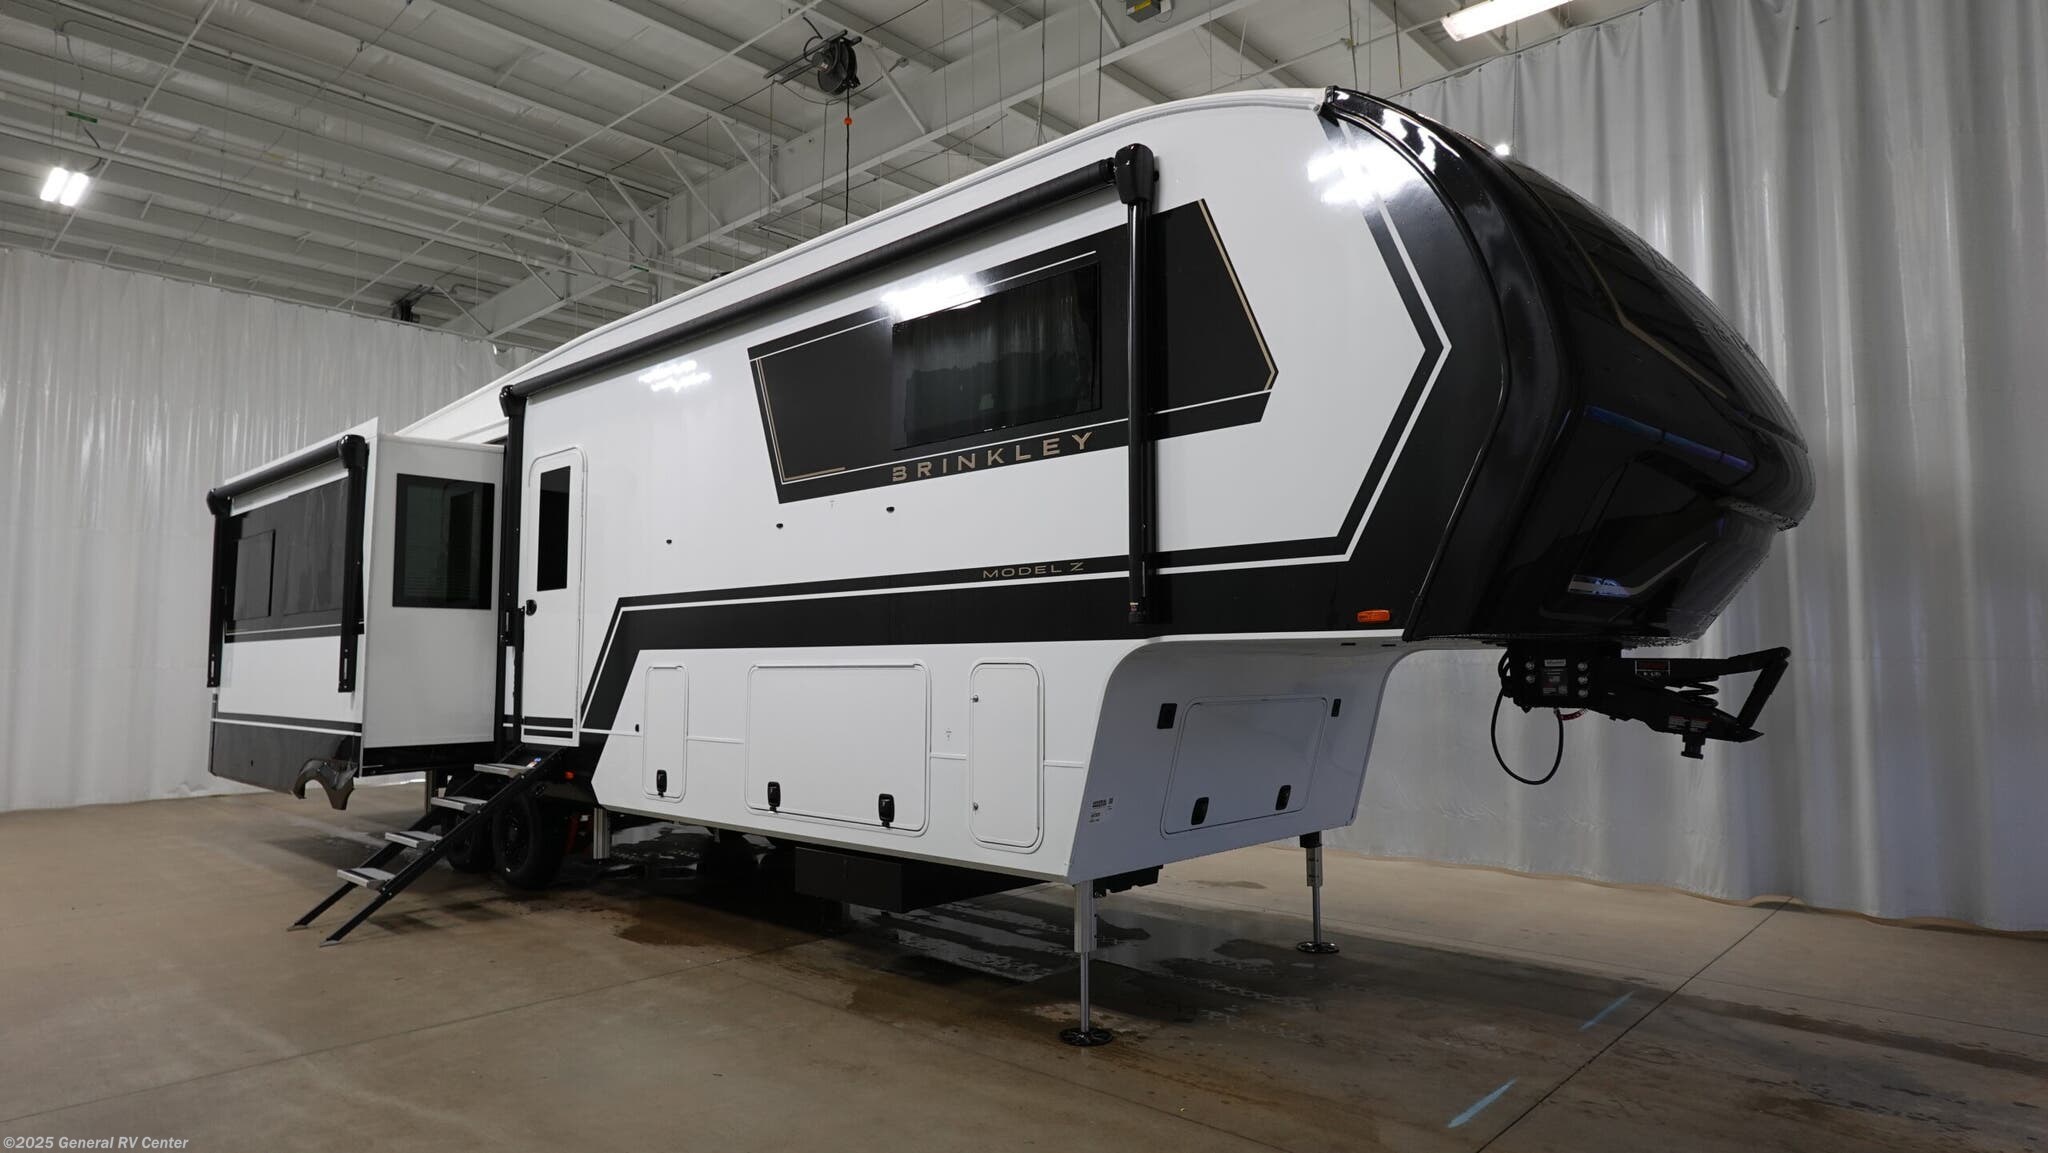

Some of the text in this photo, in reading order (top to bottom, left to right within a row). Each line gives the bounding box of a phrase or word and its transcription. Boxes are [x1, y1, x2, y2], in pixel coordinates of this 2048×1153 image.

[892, 431, 1093, 482] BRINKLEY
[982, 561, 1085, 579] MODEL Z
